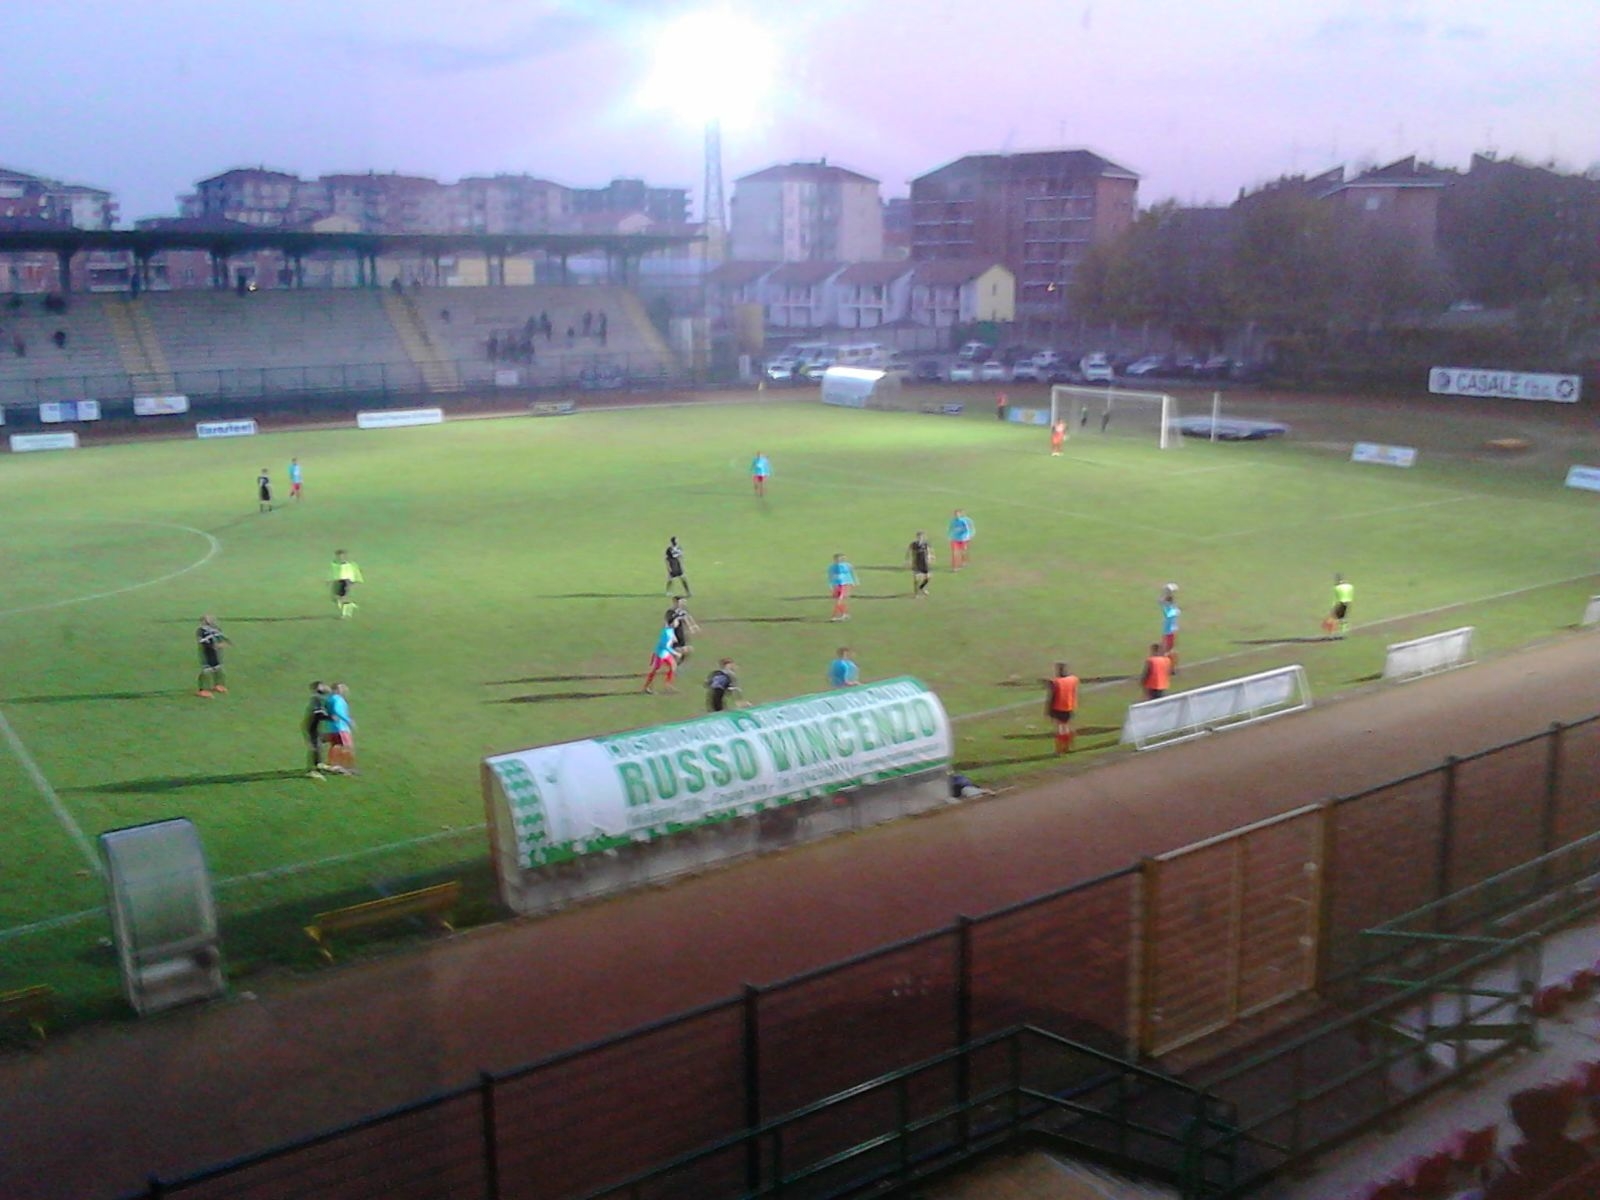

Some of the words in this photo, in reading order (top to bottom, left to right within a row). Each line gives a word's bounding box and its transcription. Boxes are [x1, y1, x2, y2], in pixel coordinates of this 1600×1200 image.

[1456, 372, 1519, 395] CASALE
[616, 737, 759, 807] RUSSO
[758, 698, 937, 772] VINCENZO
